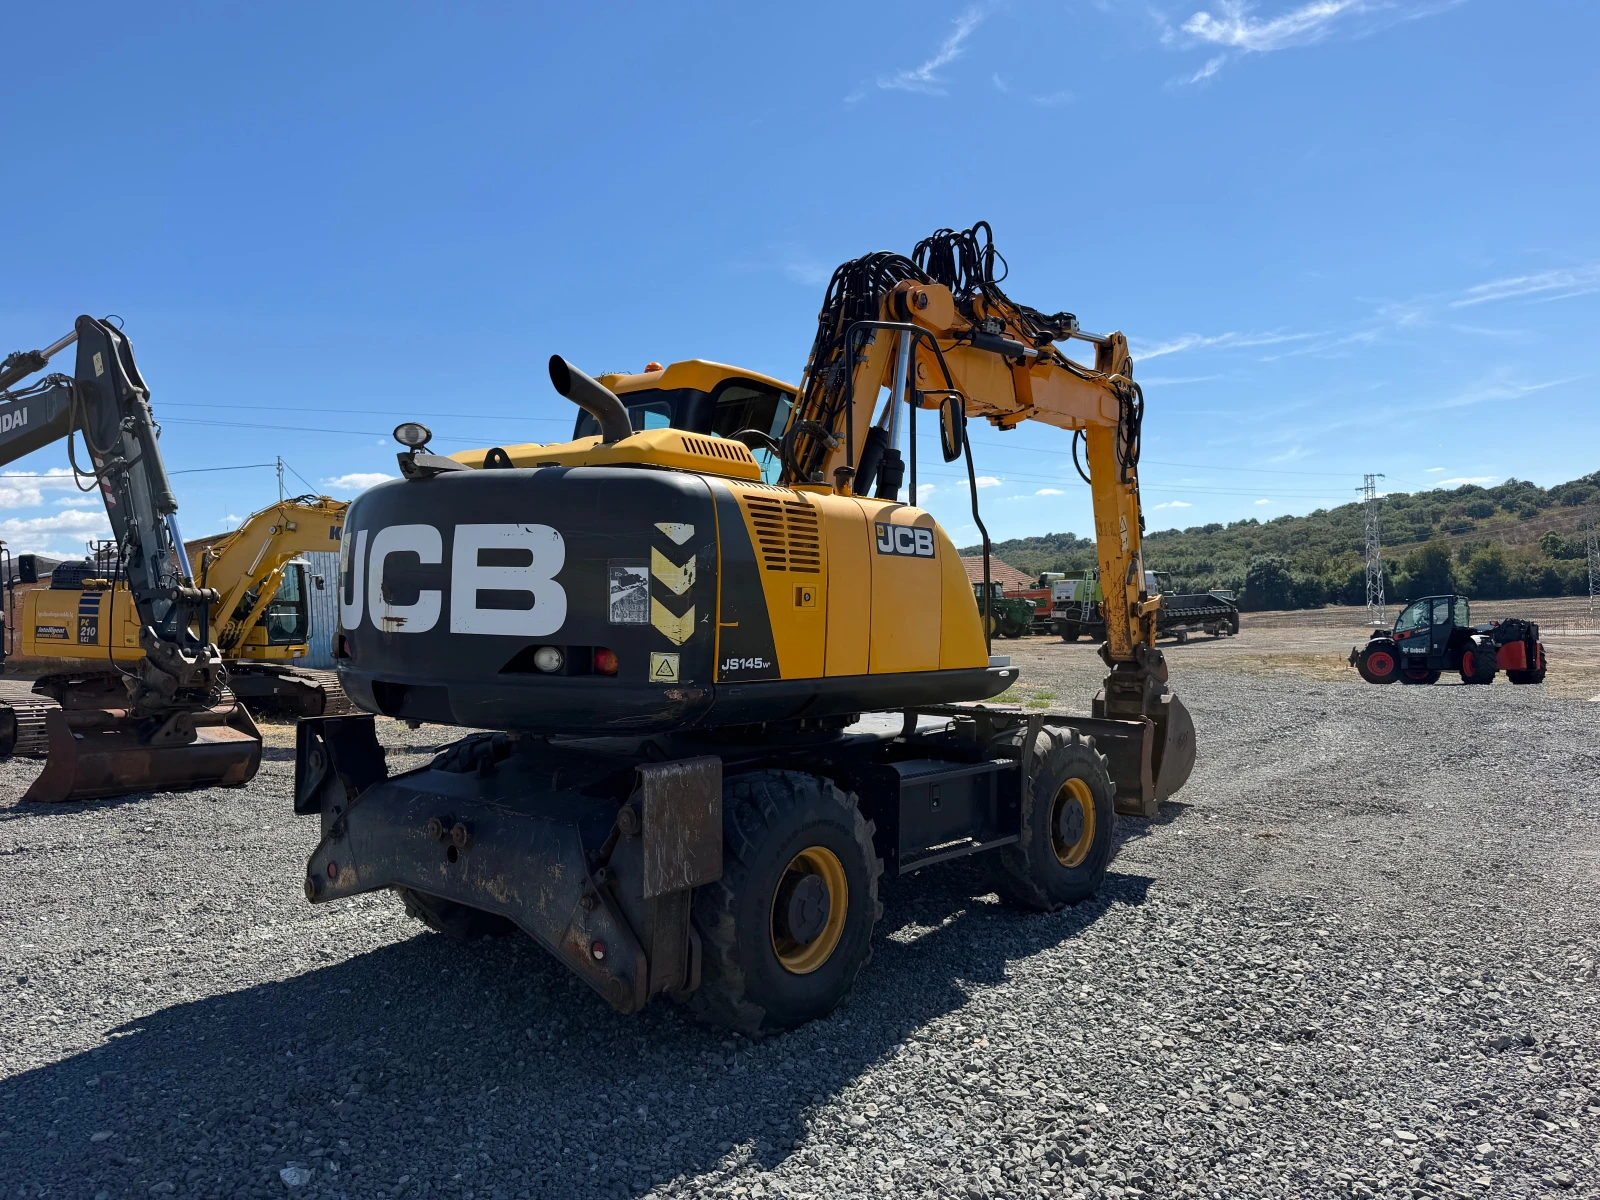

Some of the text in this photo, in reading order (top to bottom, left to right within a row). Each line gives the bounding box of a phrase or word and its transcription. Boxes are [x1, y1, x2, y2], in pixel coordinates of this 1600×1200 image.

[878, 525, 934, 556] JCB
[340, 523, 567, 636] JCB
[80, 627, 96, 636] 210
